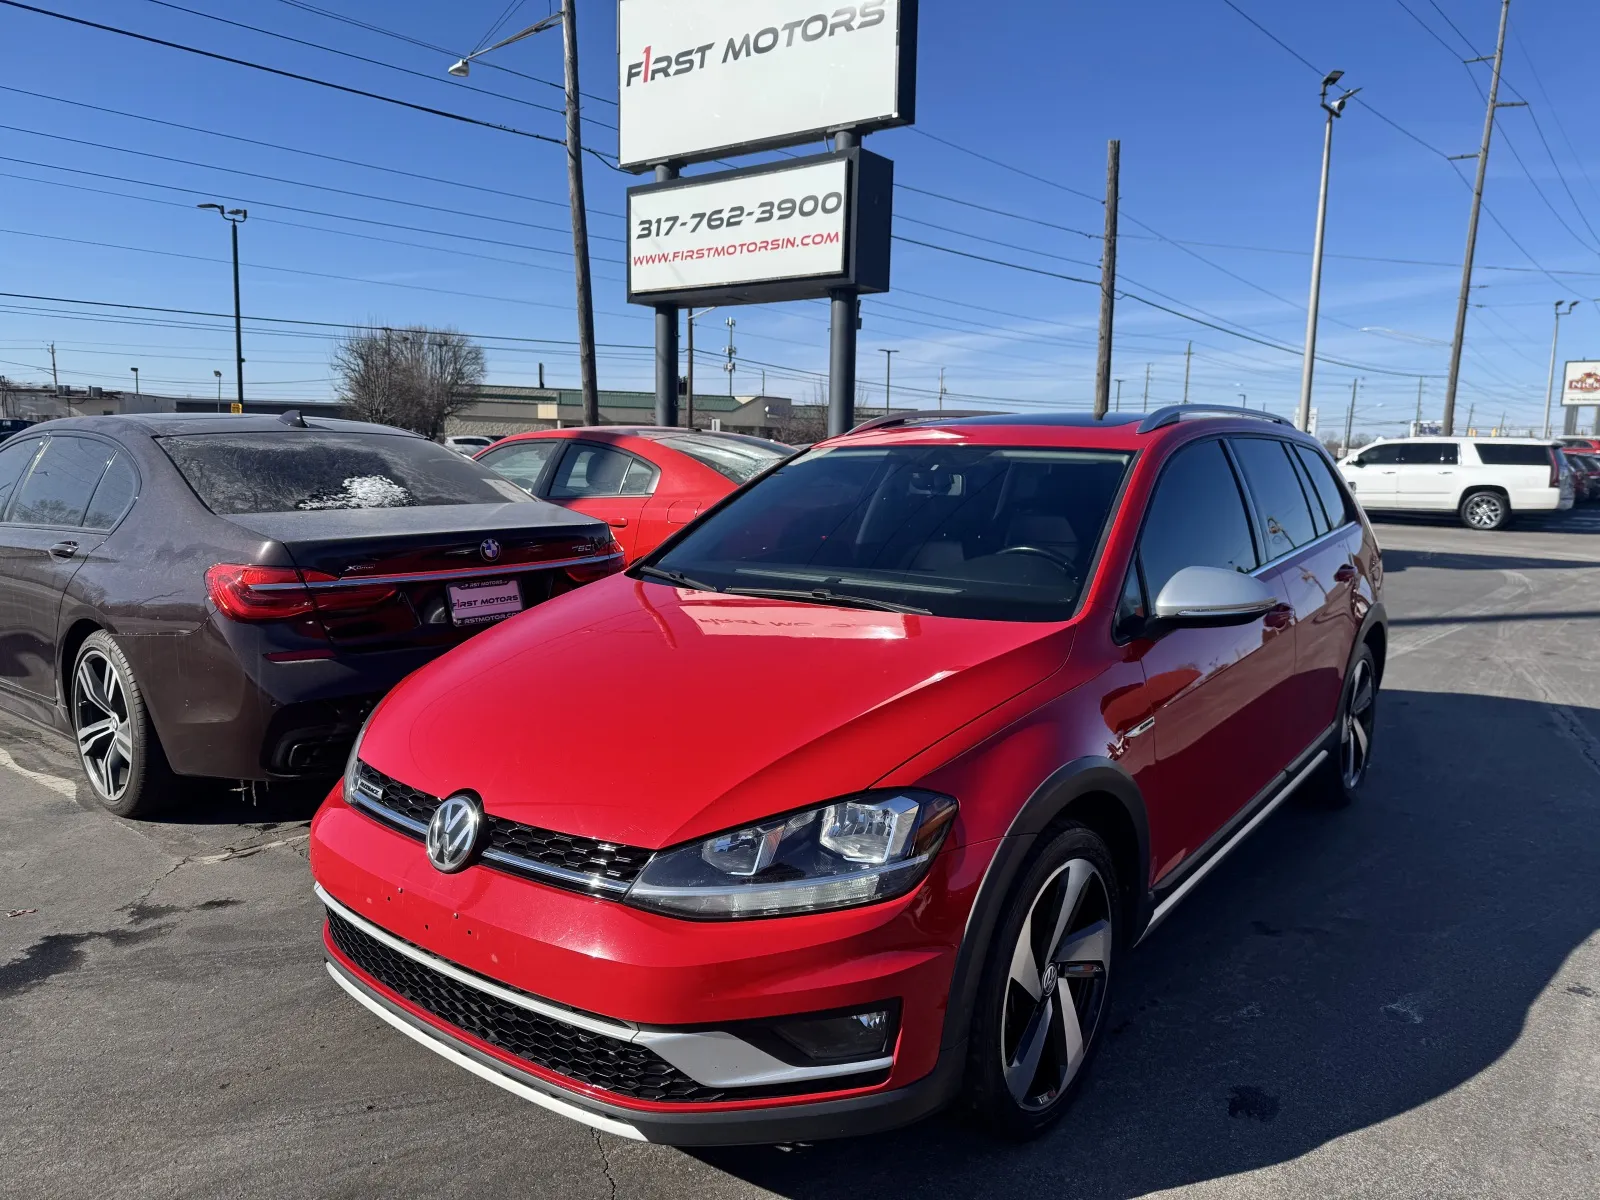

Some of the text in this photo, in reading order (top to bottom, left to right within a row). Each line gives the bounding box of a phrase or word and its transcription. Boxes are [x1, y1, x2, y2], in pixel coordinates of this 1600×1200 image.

[721, 0, 885, 63] MOTORS
[636, 191, 842, 239] 317-762-3900
[633, 231, 839, 266] WWW.FIRSTMOTORSIN.COM
[481, 594, 519, 605] MOTORS
